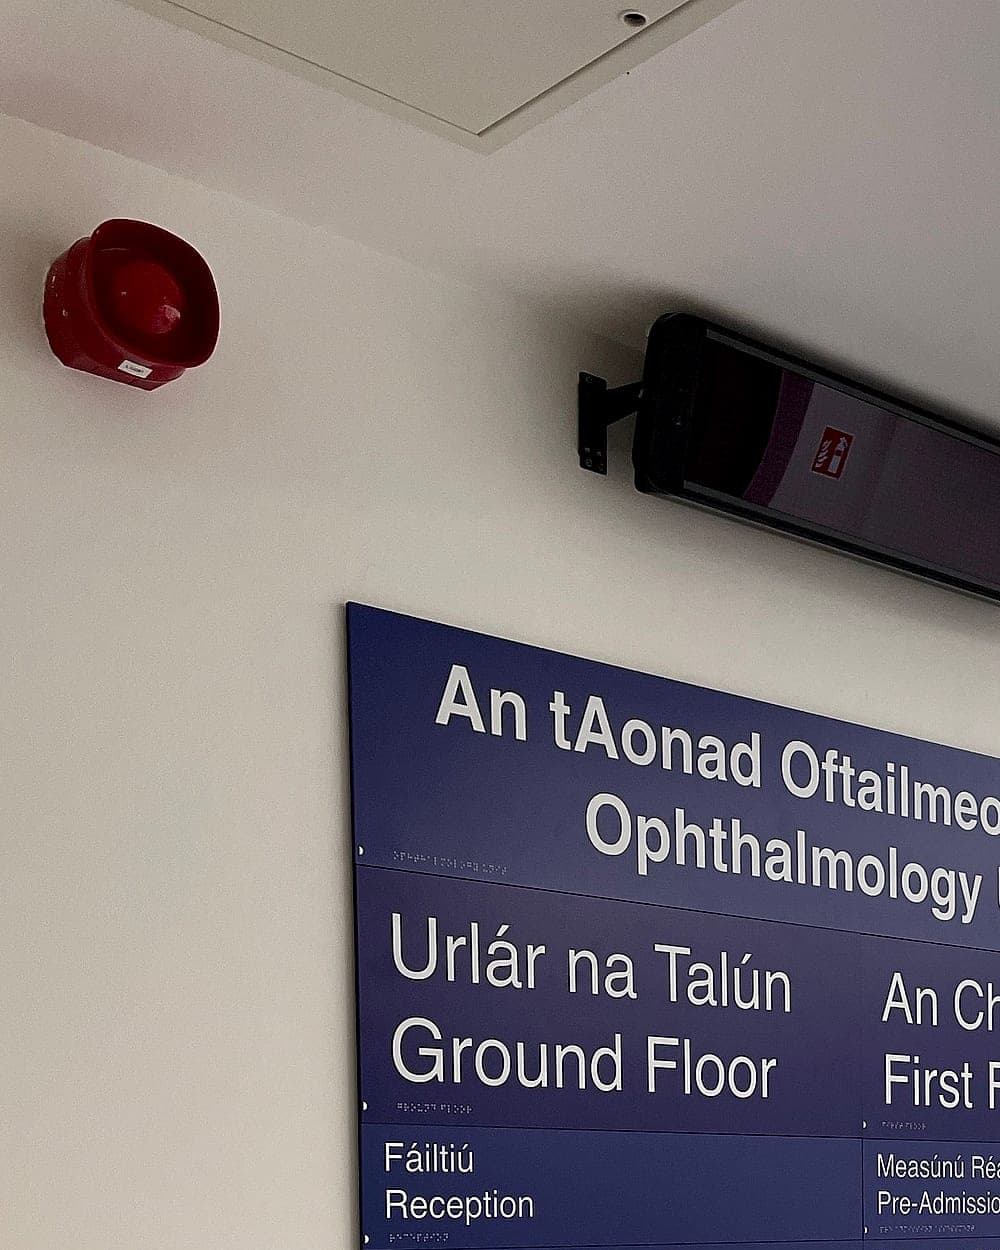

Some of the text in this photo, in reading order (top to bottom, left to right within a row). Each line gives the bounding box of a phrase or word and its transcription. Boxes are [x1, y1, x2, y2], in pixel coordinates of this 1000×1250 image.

[435, 664, 527, 741] An
[548, 690, 761, 788] tAonad
[585, 793, 983, 924] Ophthalmology
[391, 912, 791, 1013] Urlár na Talún
[881, 972, 938, 1026] An
[392, 1016, 777, 1099] Ground Floor
[885, 1053, 973, 1109] First
[384, 1142, 473, 1173] Fáiltiú
[877, 1153, 965, 1179] Measúnú
[385, 1189, 534, 1226] Reception
